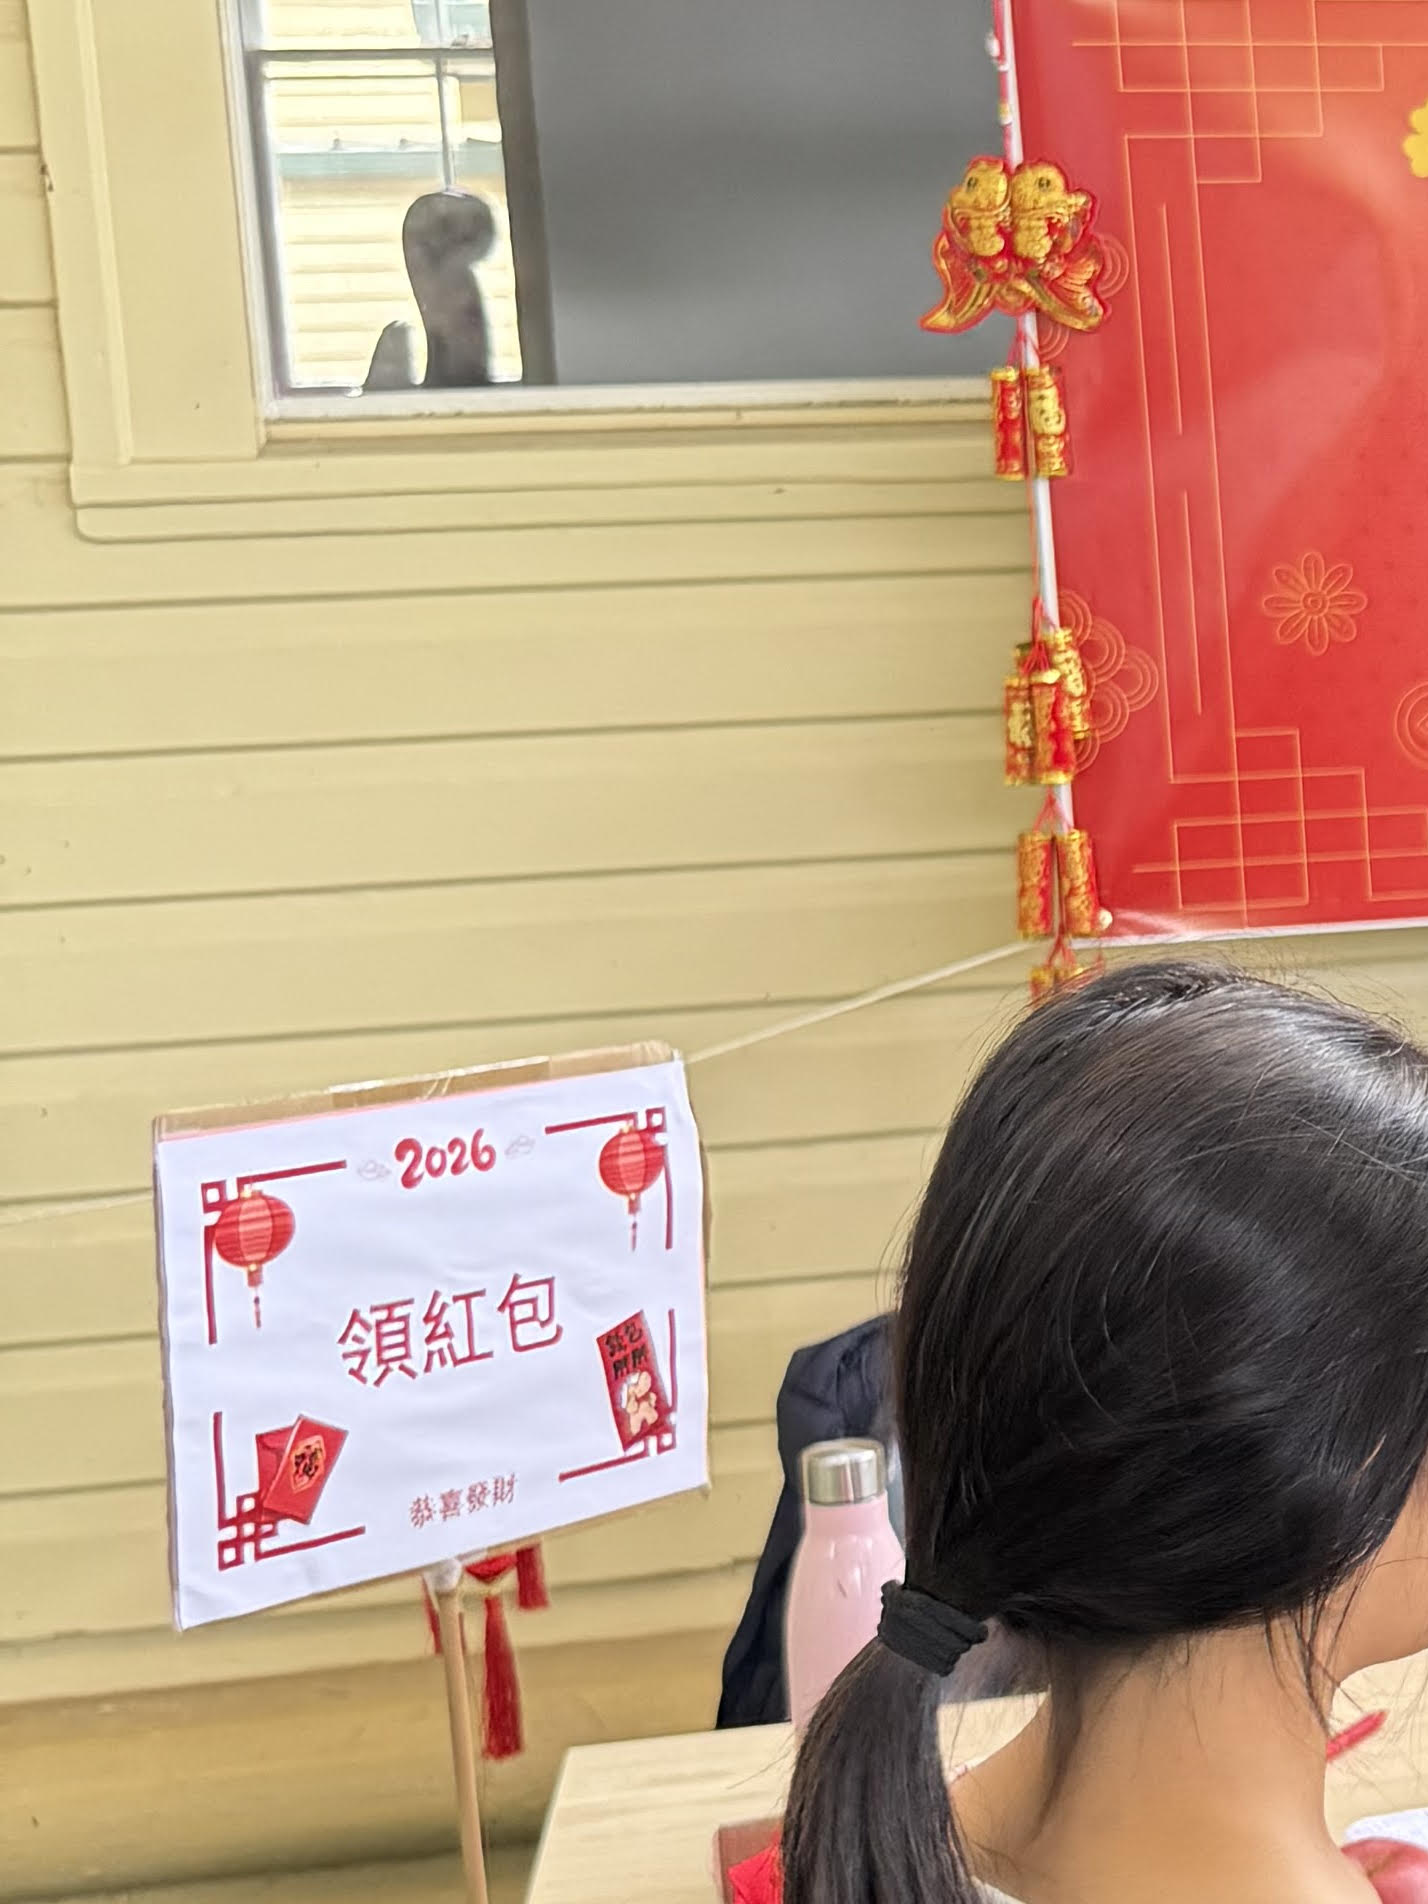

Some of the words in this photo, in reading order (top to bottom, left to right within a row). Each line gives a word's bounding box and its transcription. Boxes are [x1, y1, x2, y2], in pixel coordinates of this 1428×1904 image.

[393, 1127, 498, 1190] 2026
[337, 1272, 565, 1388] 領紅包
[409, 1471, 517, 1529] 恭喜發財
